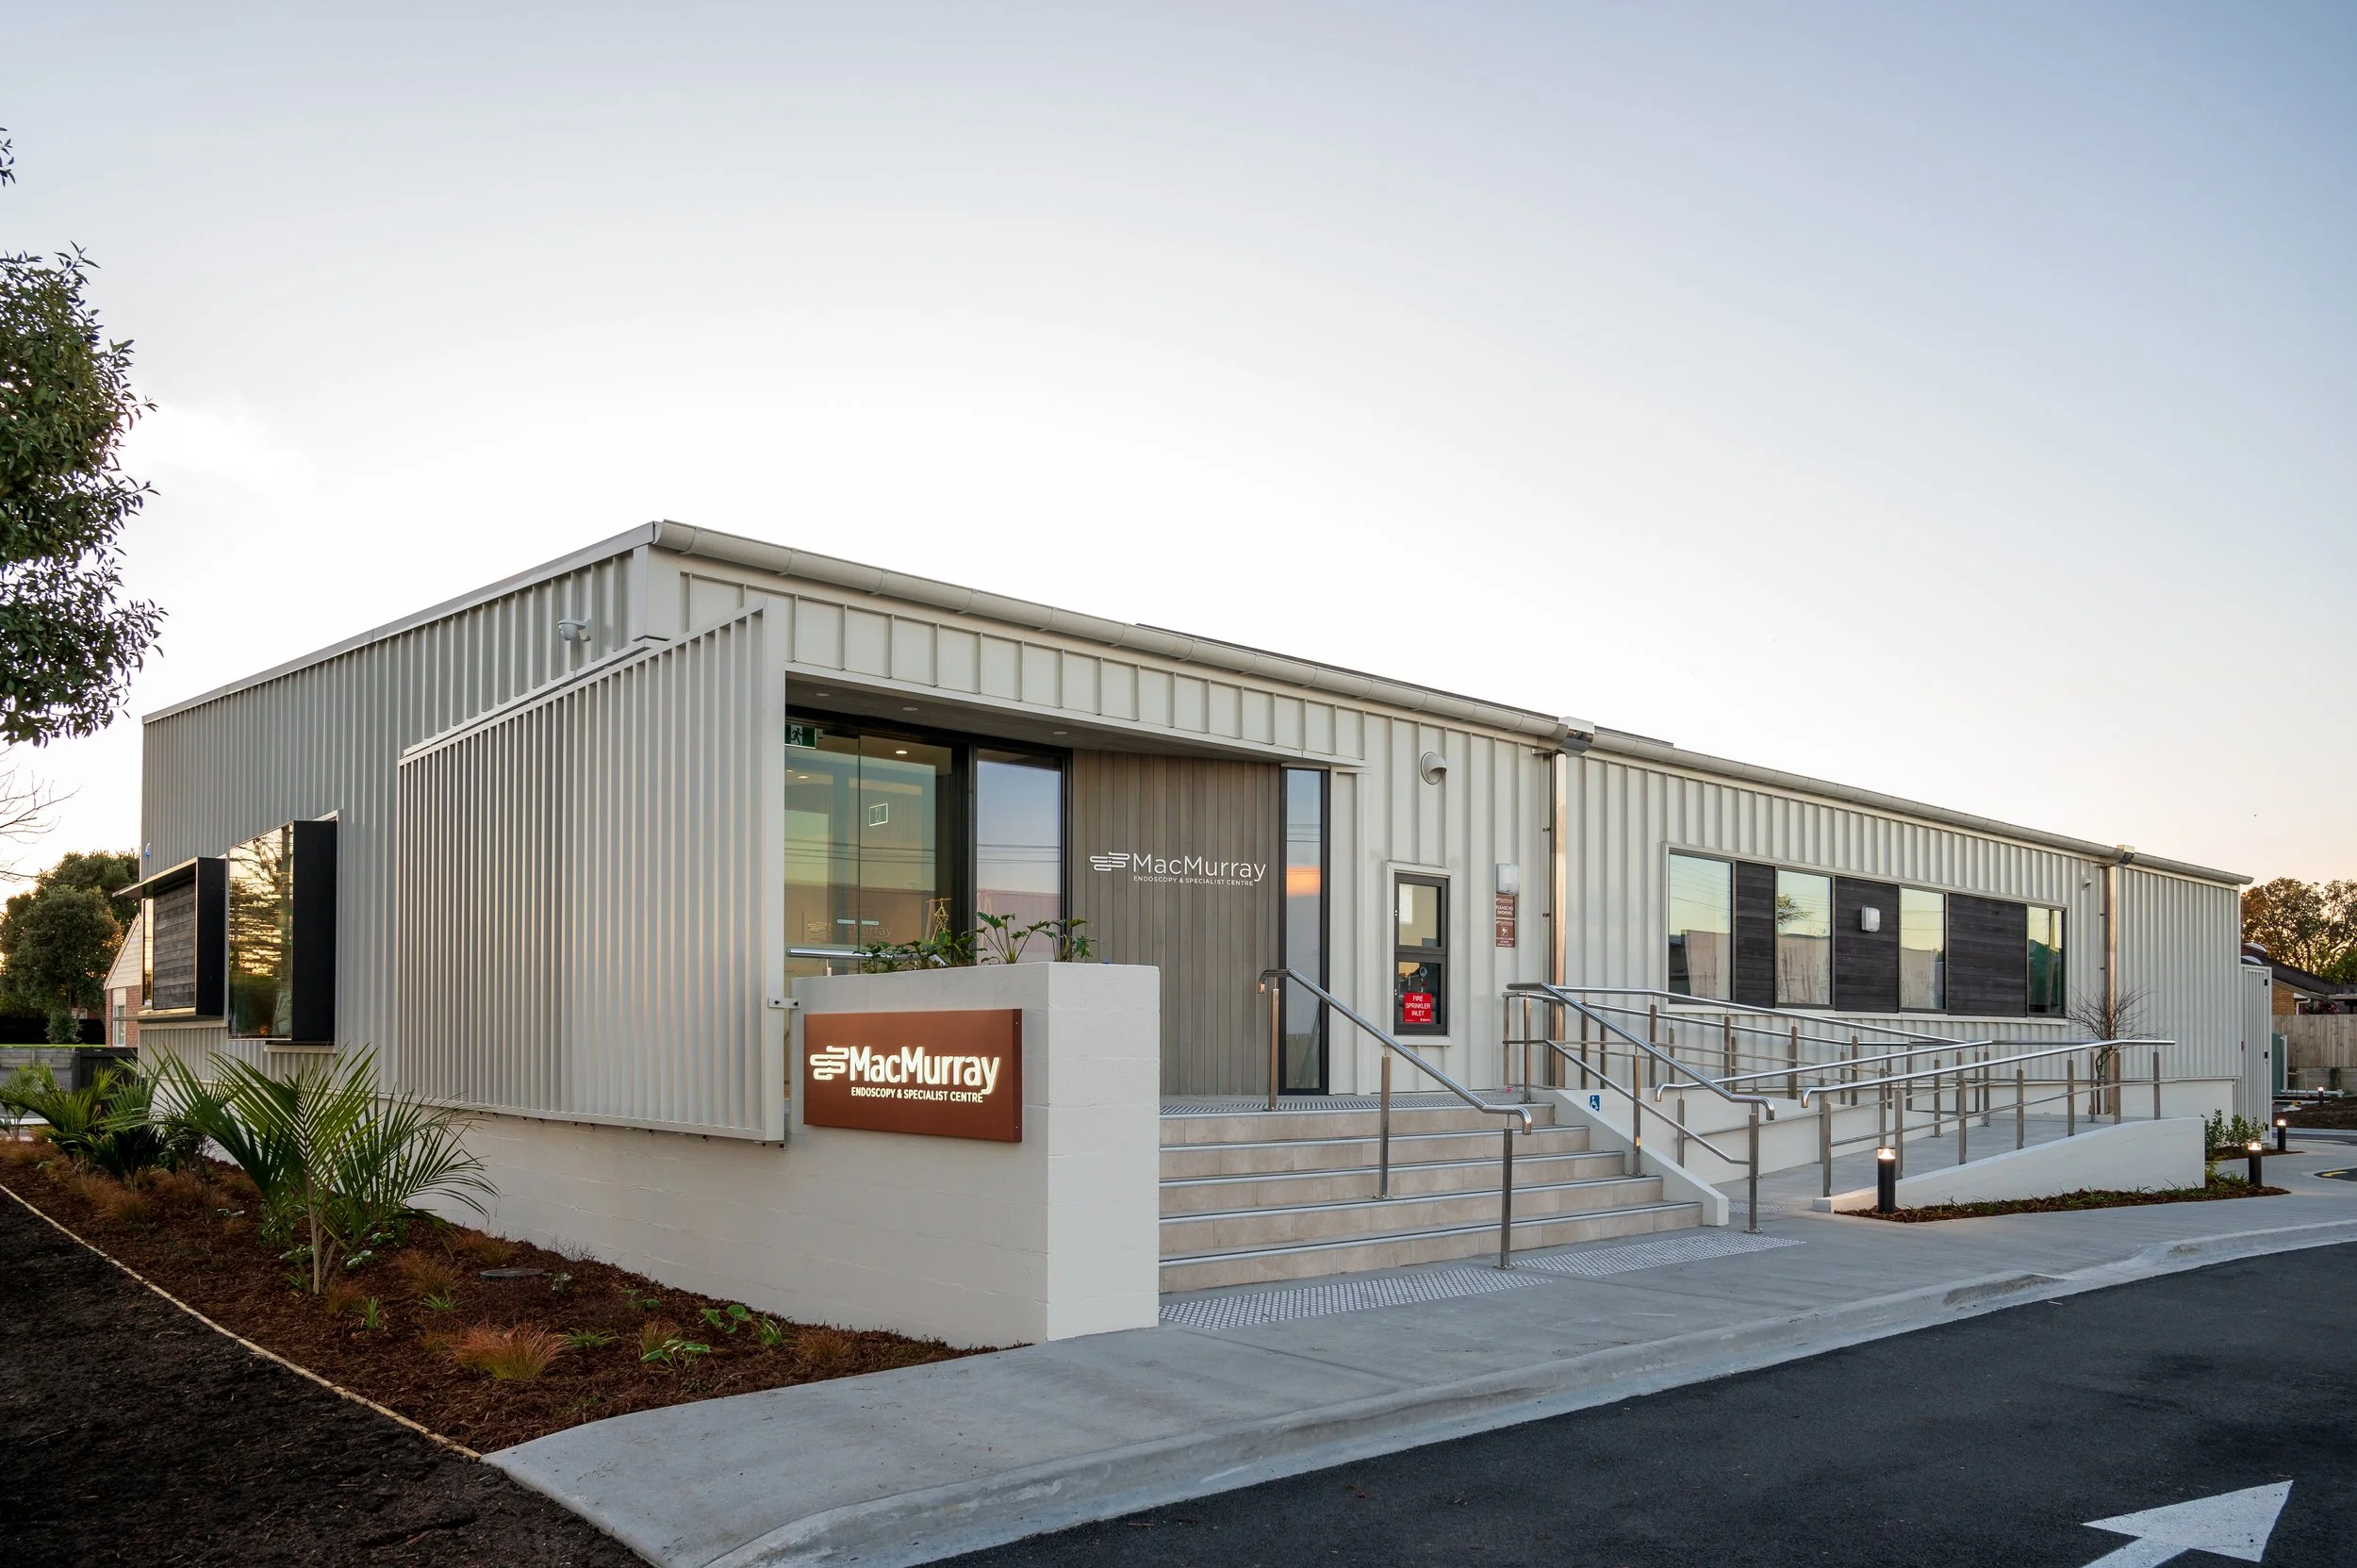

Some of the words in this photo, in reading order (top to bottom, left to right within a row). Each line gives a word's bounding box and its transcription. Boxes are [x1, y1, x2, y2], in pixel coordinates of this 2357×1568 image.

[1133, 852, 1266, 883] MacMurray
[1185, 877, 1225, 885] SPECIALIST
[849, 1046, 1000, 1095] MacMurray
[850, 1086, 896, 1098] ENDOSCOPY
[897, 1088, 902, 1098] &
[903, 1089, 948, 1101] SPECIALIST
[949, 1091, 983, 1103] CENTRE
